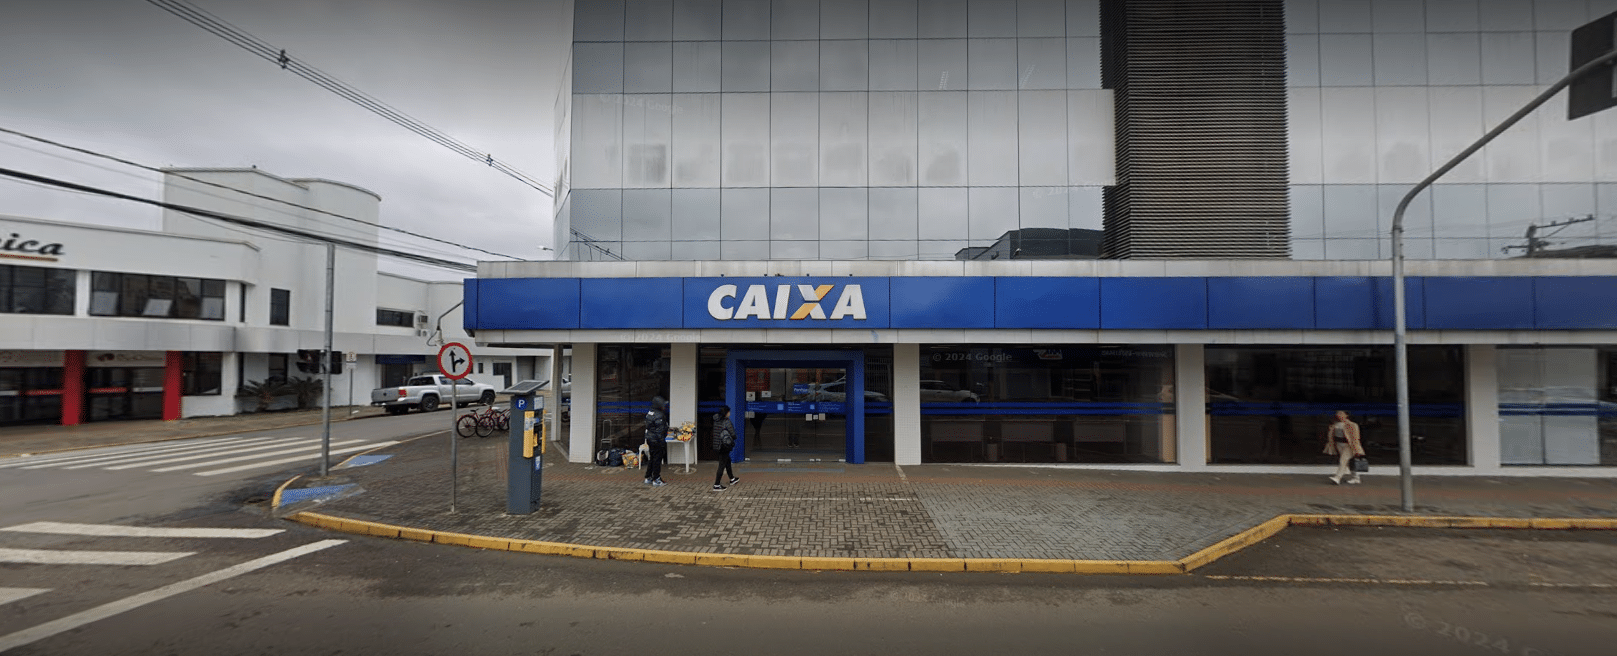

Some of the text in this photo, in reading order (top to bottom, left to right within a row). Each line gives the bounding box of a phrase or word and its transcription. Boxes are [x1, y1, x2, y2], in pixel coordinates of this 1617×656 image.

[0, 233, 65, 256] ica
[707, 284, 867, 320] CAIXA
[518, 399, 526, 408] P
